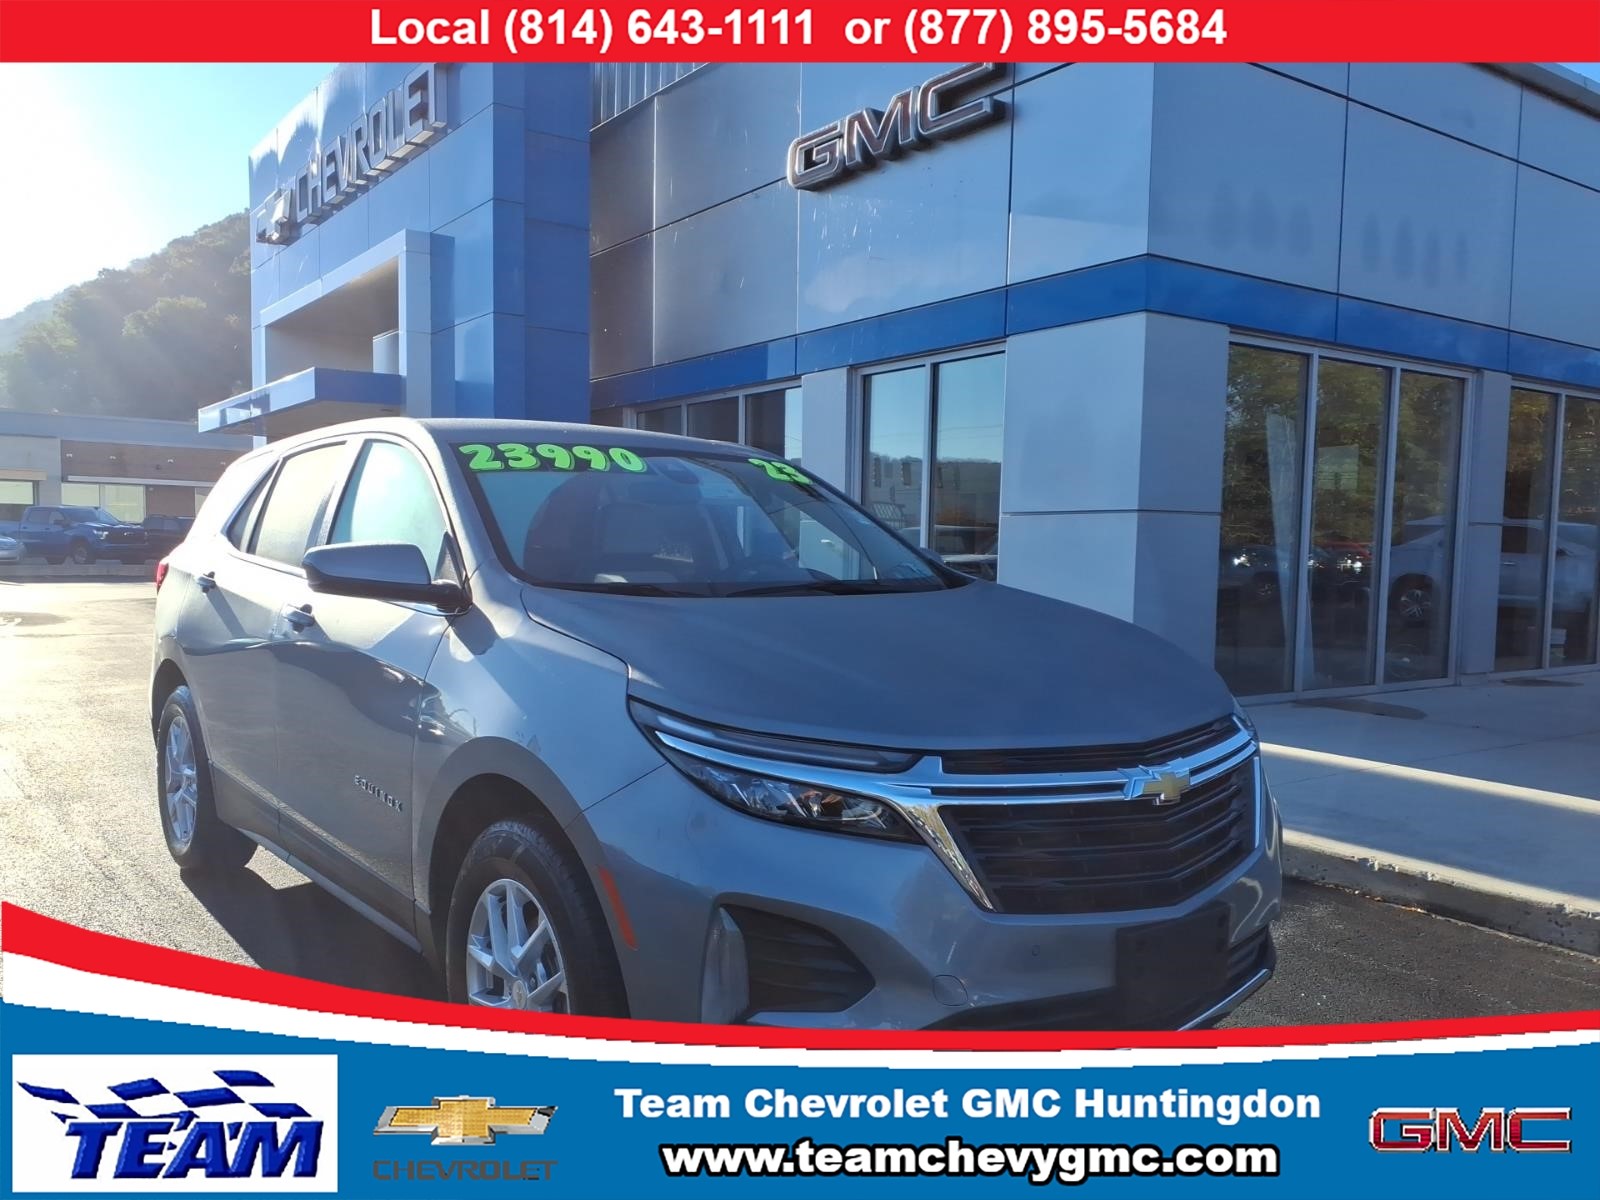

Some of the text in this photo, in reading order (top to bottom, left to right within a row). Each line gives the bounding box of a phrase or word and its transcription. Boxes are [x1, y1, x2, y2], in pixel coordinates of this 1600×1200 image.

[787, 62, 1008, 190] GMC
[458, 443, 649, 473] 23990
[354, 775, 403, 812] EQUINOX
